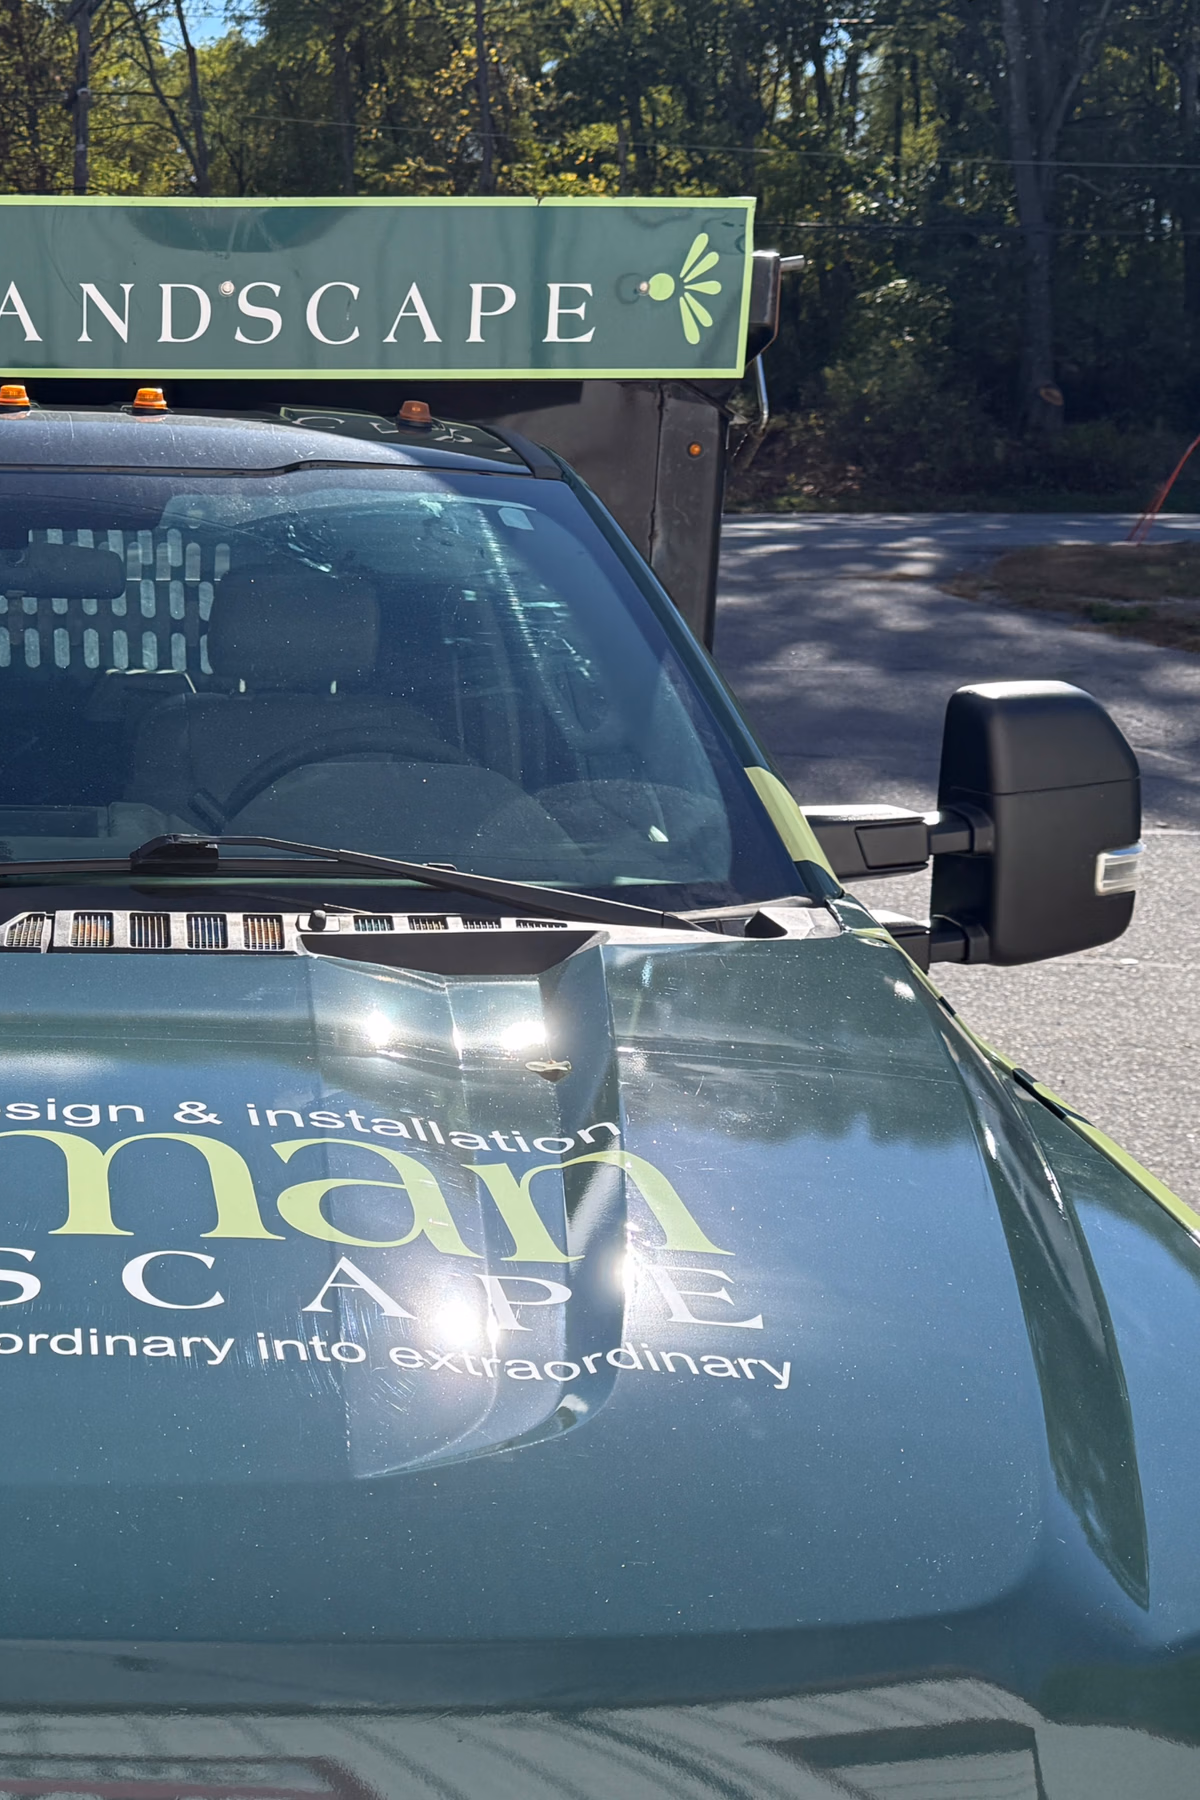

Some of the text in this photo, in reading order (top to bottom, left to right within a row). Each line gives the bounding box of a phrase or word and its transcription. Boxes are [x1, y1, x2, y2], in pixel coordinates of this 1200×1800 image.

[173, 1100, 223, 1126] &
[246, 1103, 621, 1154] installation
[257, 1332, 367, 1364] into
[389, 1342, 792, 1390] extraordinary
